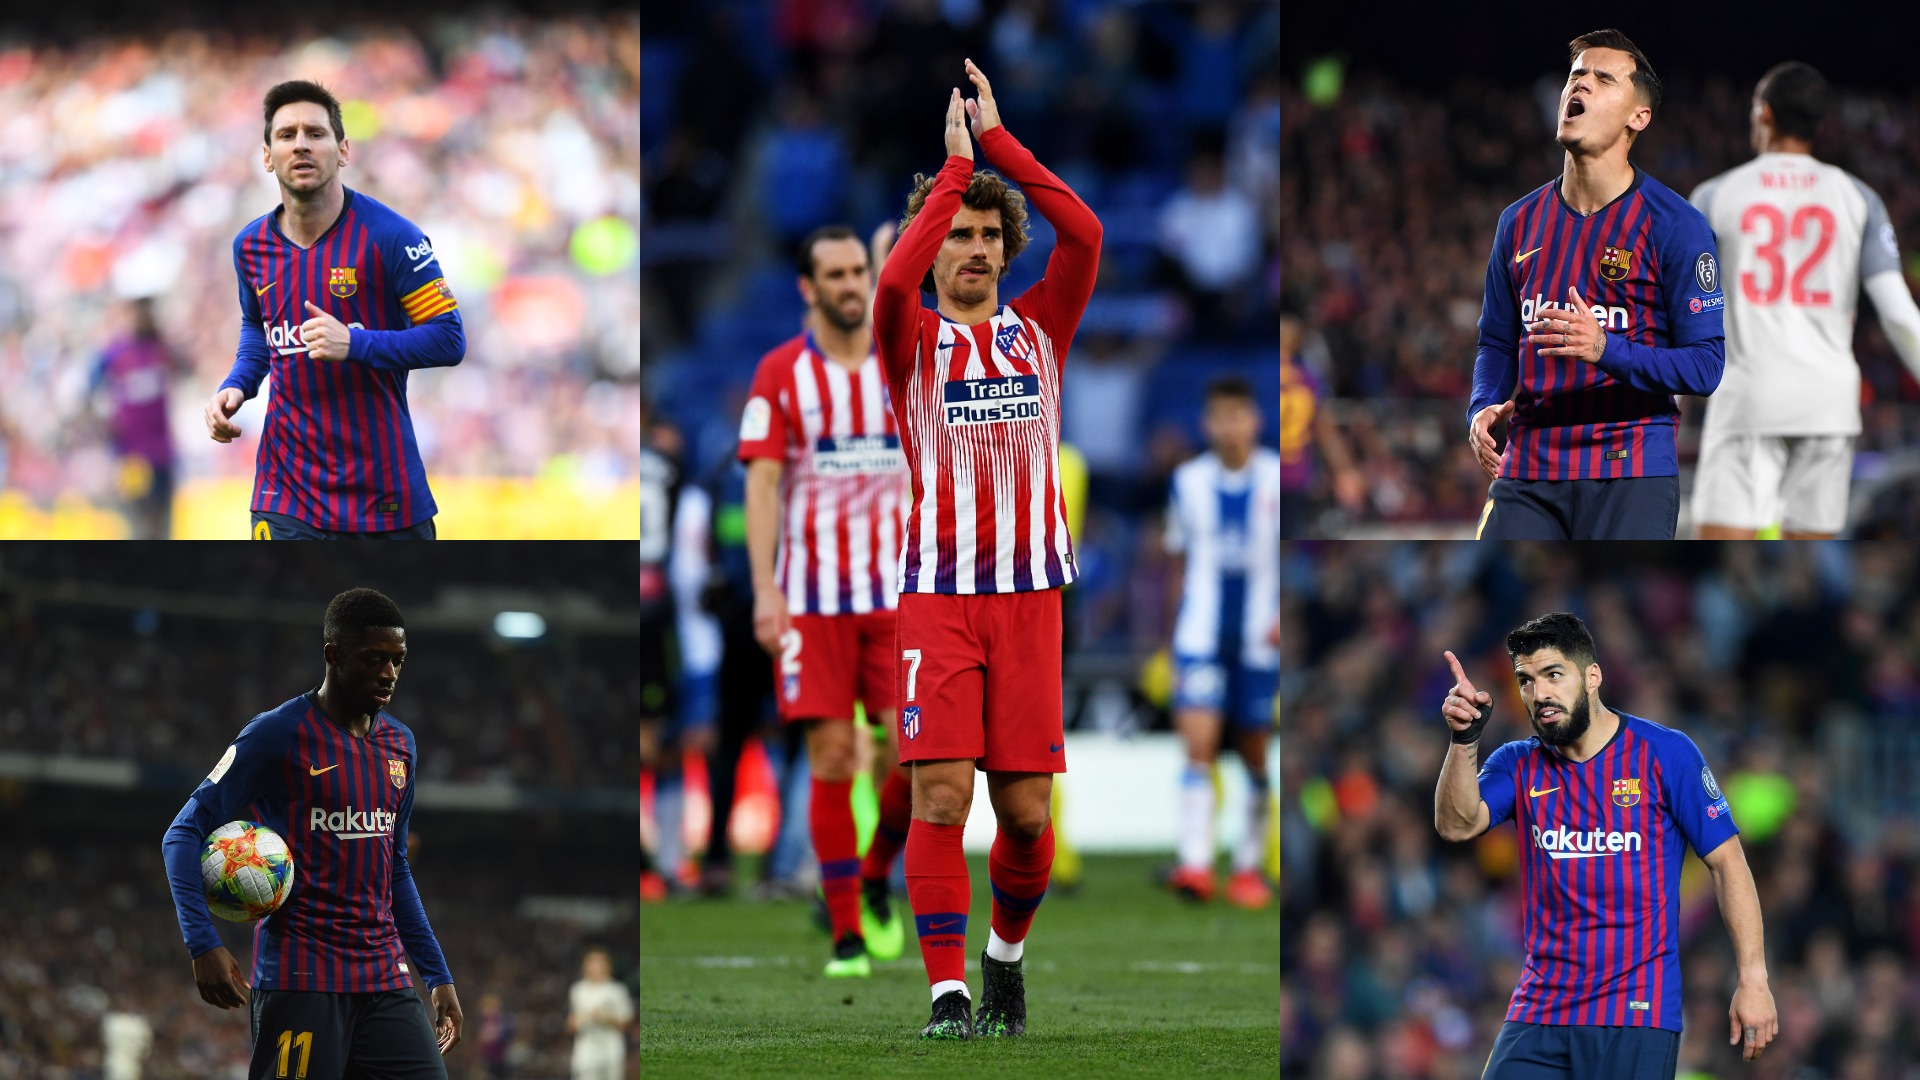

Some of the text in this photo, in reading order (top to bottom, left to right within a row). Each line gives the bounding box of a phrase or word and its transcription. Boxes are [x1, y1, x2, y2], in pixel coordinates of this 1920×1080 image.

[1740, 202, 1836, 306] 32
[1705, 271, 1712, 283] 5
[965, 378, 1024, 399] Trade
[947, 402, 1040, 424] Plus500
[780, 628, 803, 675] 2
[903, 648, 922, 702] 7
[310, 805, 397, 831] Rakuten
[1531, 825, 1642, 852] Rakuten
[276, 1029, 314, 1080] 11
